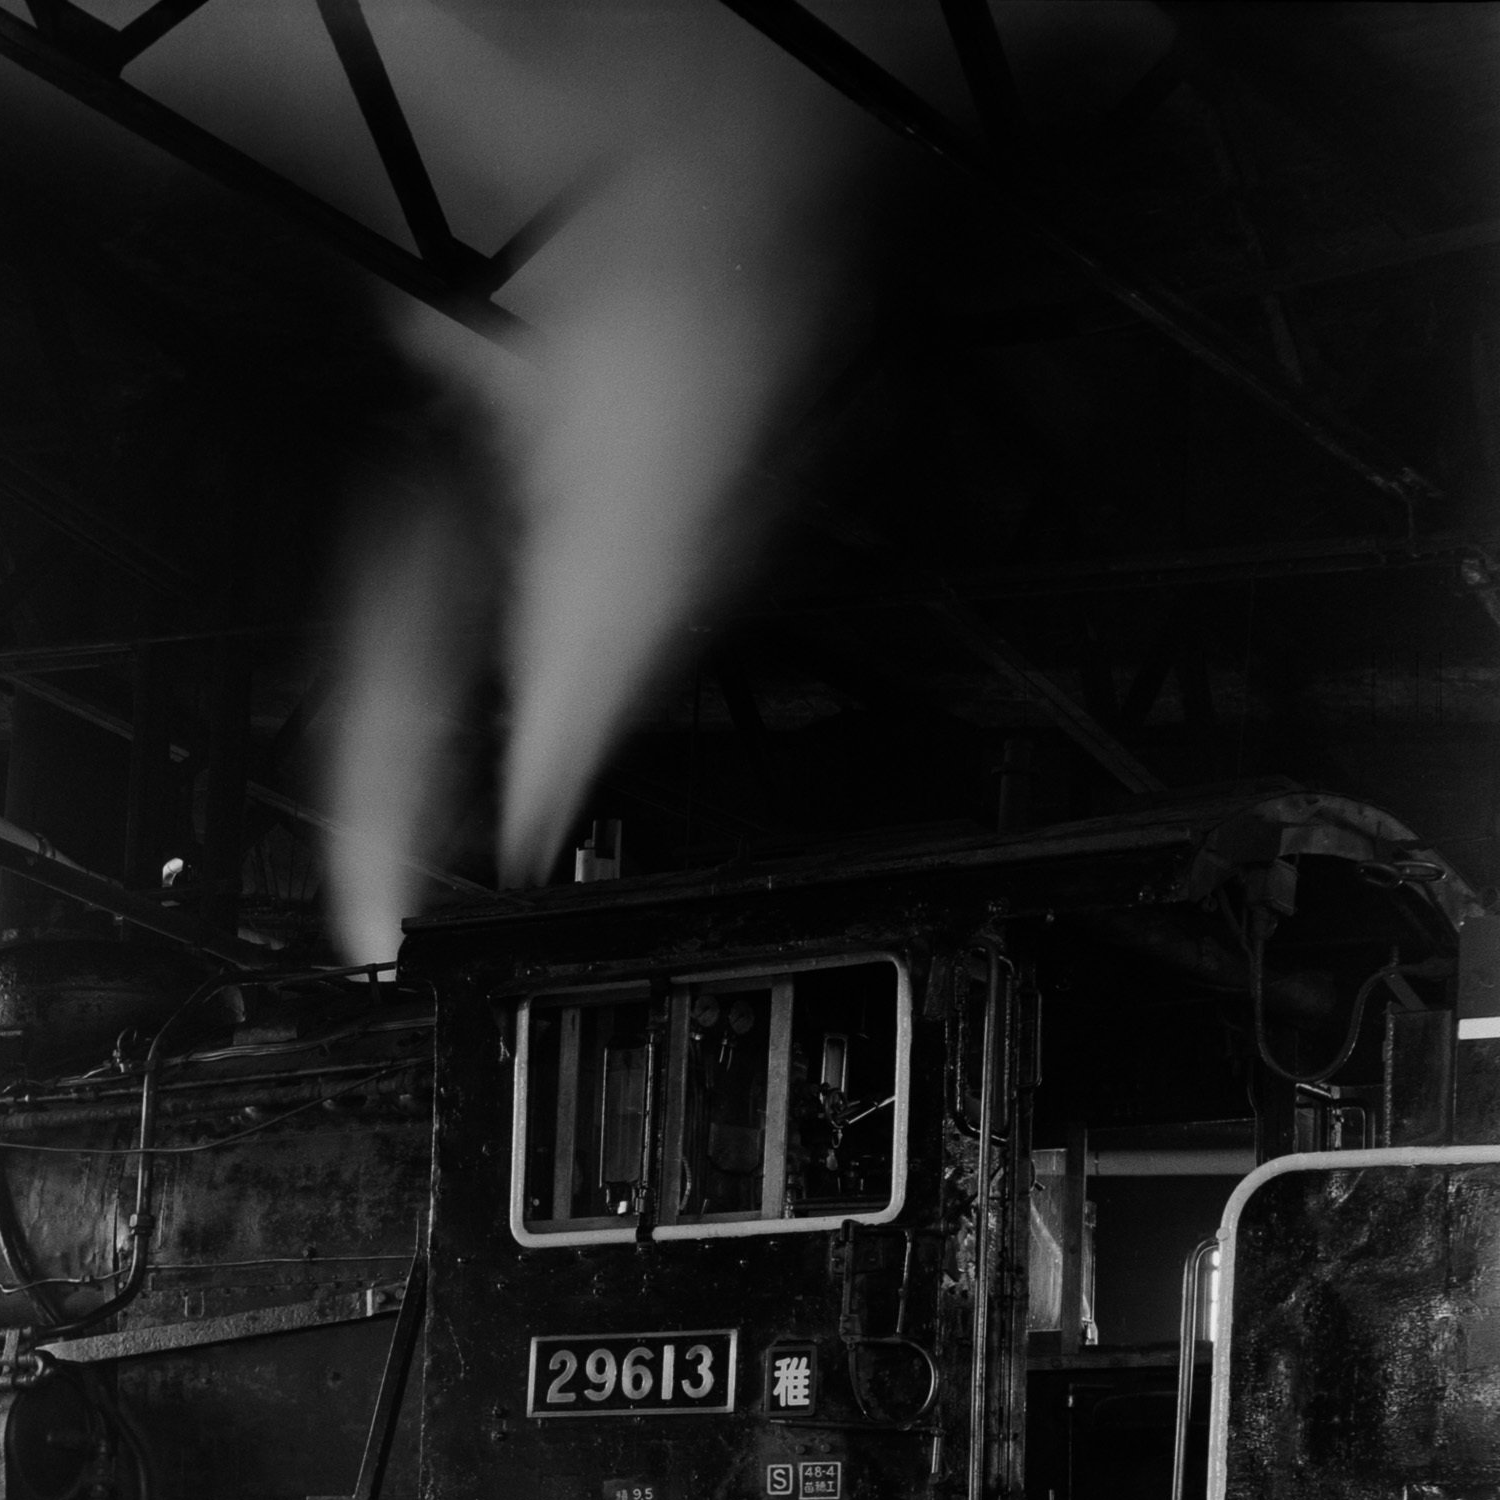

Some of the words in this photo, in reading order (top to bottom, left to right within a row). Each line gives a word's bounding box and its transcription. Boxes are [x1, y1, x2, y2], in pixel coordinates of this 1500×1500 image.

[546, 1344, 715, 1403] 29613
[772, 1356, 811, 1408] 稚
[772, 1468, 788, 1490] S
[804, 1465, 837, 1478] 48-4
[632, 1487, 654, 1500] 9.5
